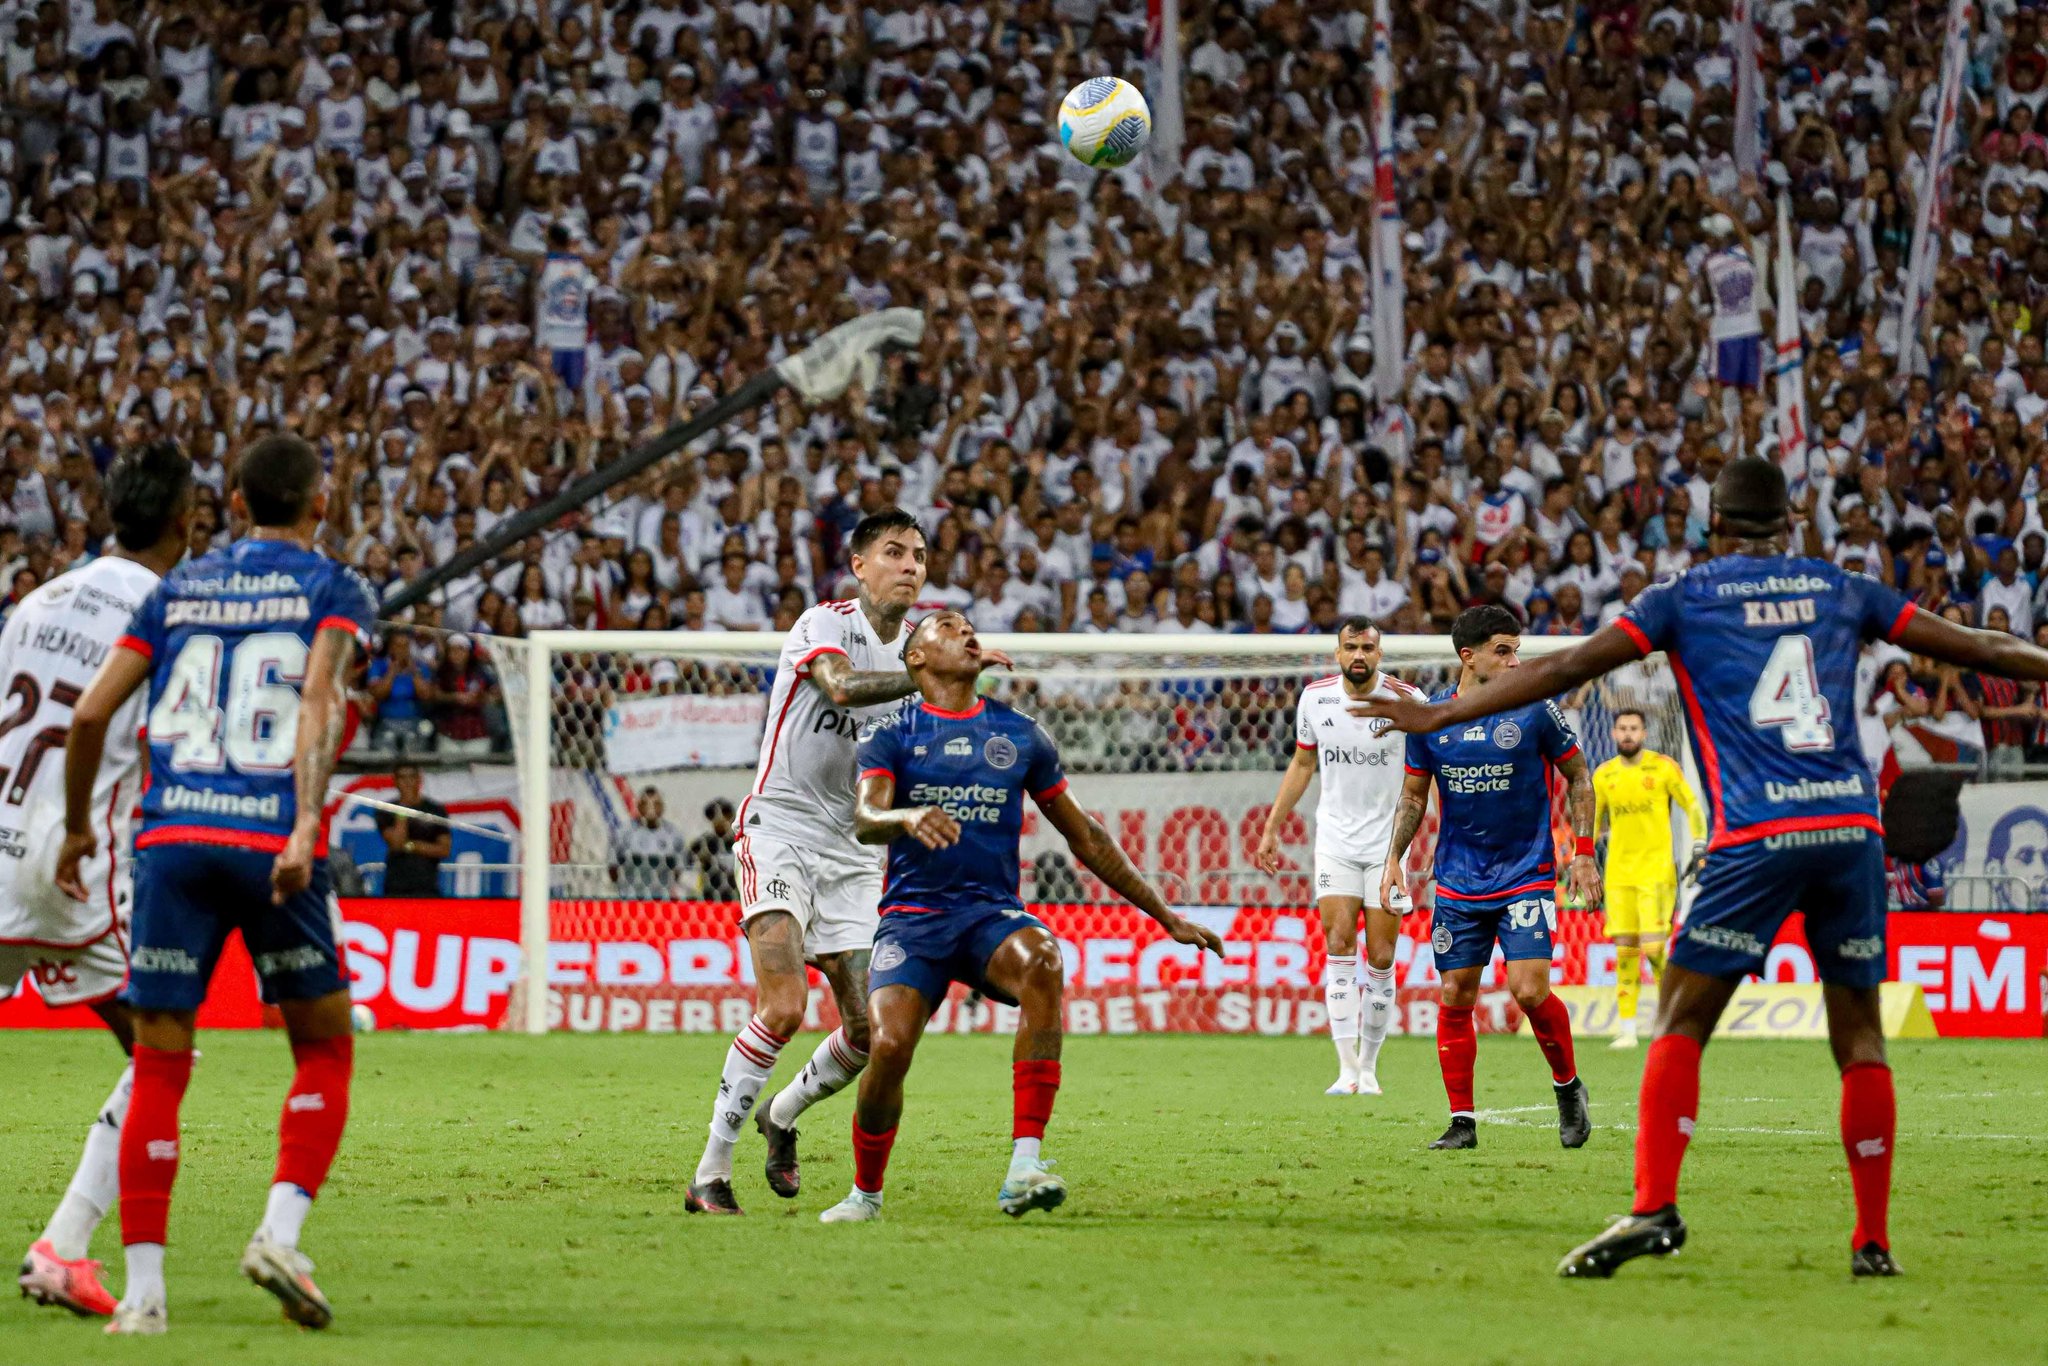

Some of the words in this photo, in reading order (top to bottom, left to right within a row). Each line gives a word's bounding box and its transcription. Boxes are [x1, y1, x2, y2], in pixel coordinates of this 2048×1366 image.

[1717, 574, 1832, 597] meutudo.
[1743, 598, 1816, 626] KANU
[150, 632, 312, 777] 46
[1748, 633, 1835, 752] 4
[814, 708, 873, 742] pix
[1325, 747, 1389, 767] pixbet
[1441, 763, 1513, 783] Esportes
[162, 785, 280, 818] Unimed
[909, 783, 1008, 804] Esportes
[1764, 774, 1863, 802] Unimed
[1764, 826, 1867, 851] Unimed
